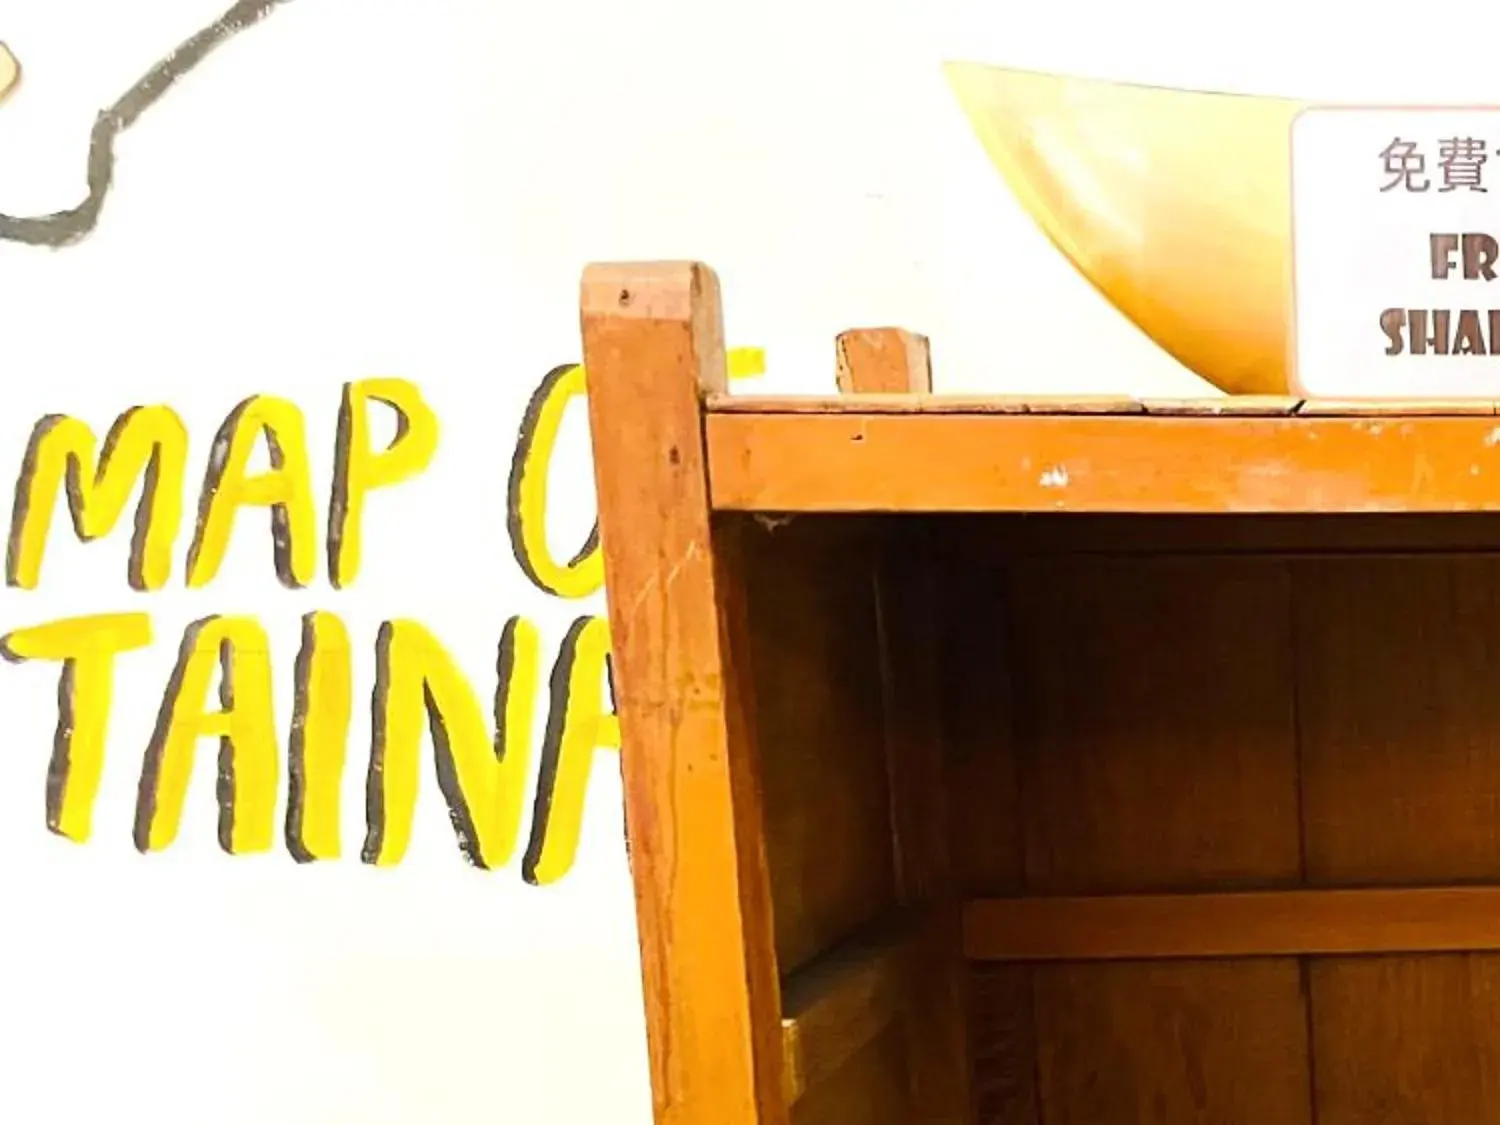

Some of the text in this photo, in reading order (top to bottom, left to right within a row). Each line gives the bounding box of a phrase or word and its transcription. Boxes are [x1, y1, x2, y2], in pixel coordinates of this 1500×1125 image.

[5, 362, 606, 598] MAP O
[0, 610, 622, 886] TAINA
